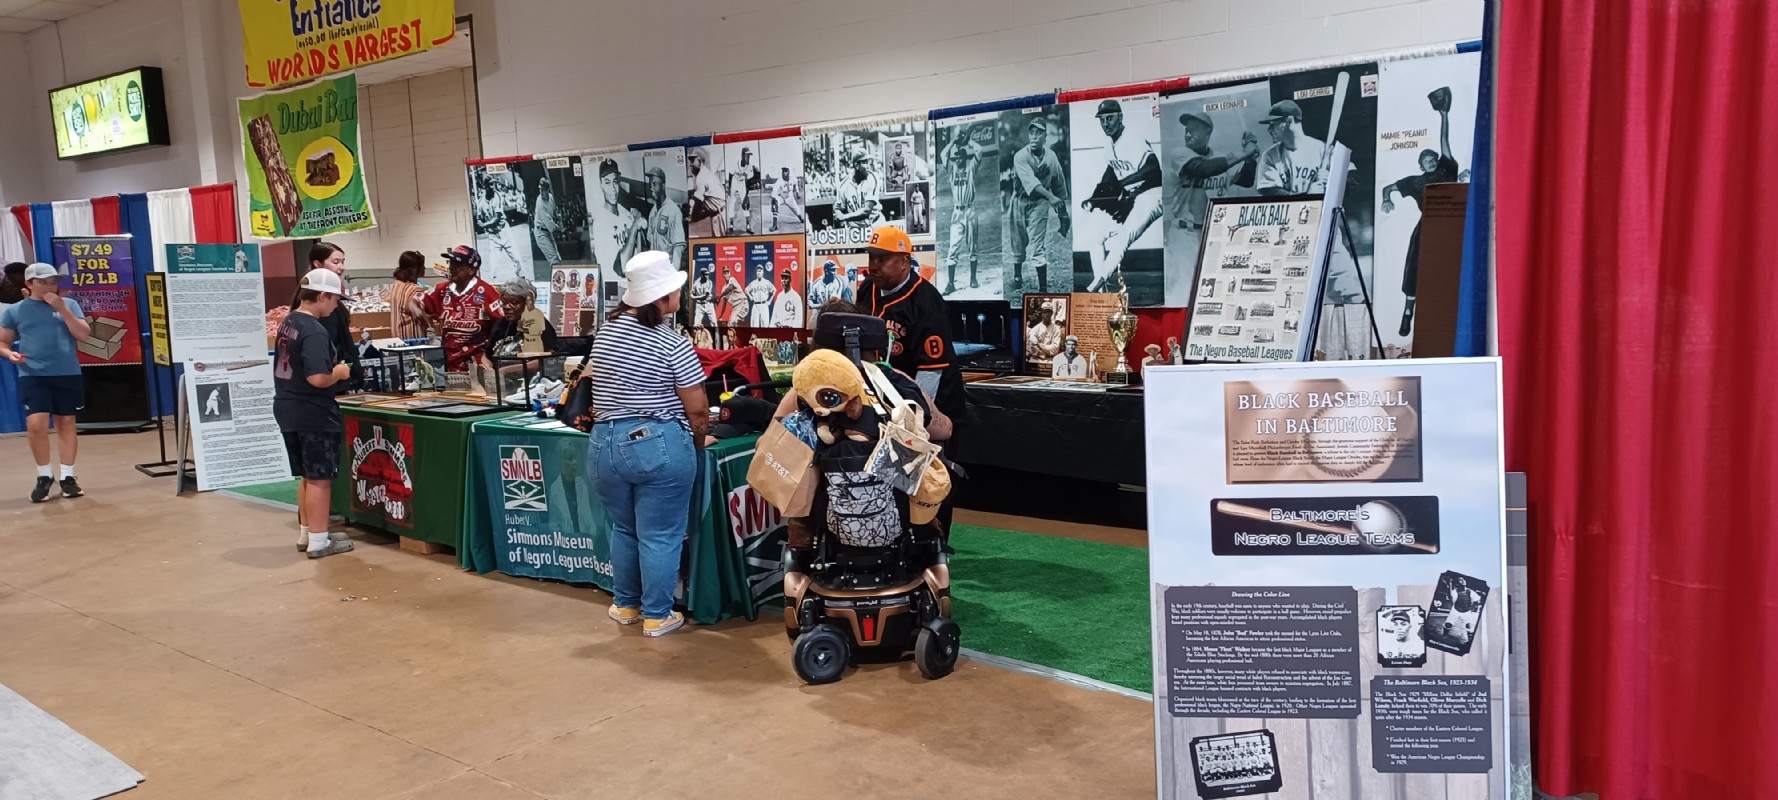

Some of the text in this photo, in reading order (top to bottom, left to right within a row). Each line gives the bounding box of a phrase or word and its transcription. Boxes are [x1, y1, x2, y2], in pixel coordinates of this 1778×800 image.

[278, 89, 358, 134] Dubai Bar
[1220, 100, 1244, 110] LEONARD
[1381, 132, 1400, 140] MAMIE
[1390, 141, 1418, 150] JOHNSON
[1238, 204, 1290, 226] BLACK BALL
[317, 217, 338, 229] FRONT
[810, 230, 847, 245] JOSH
[870, 233, 879, 244] B
[72, 244, 113, 256] $7.49
[77, 258, 110, 270] FOR
[72, 272, 119, 286] 1/2 LB
[929, 340, 939, 355] B
[1190, 344, 1293, 360] The Negro Baseball Leagues
[1238, 391, 1409, 410] BLACK BASEBALL
[1256, 416, 1398, 434] IN BALTIMORE
[501, 460, 542, 481] SMNLB
[770, 461, 790, 478] AT&T
[1269, 505, 1370, 522] BALTIMORE'S
[507, 528, 594, 550] Simmons Museum
[1234, 531, 1415, 546] NEGRO LEAGUE TEAMS
[509, 547, 522, 562] of
[524, 548, 551, 568] Negro
[553, 550, 593, 572] Leagues
